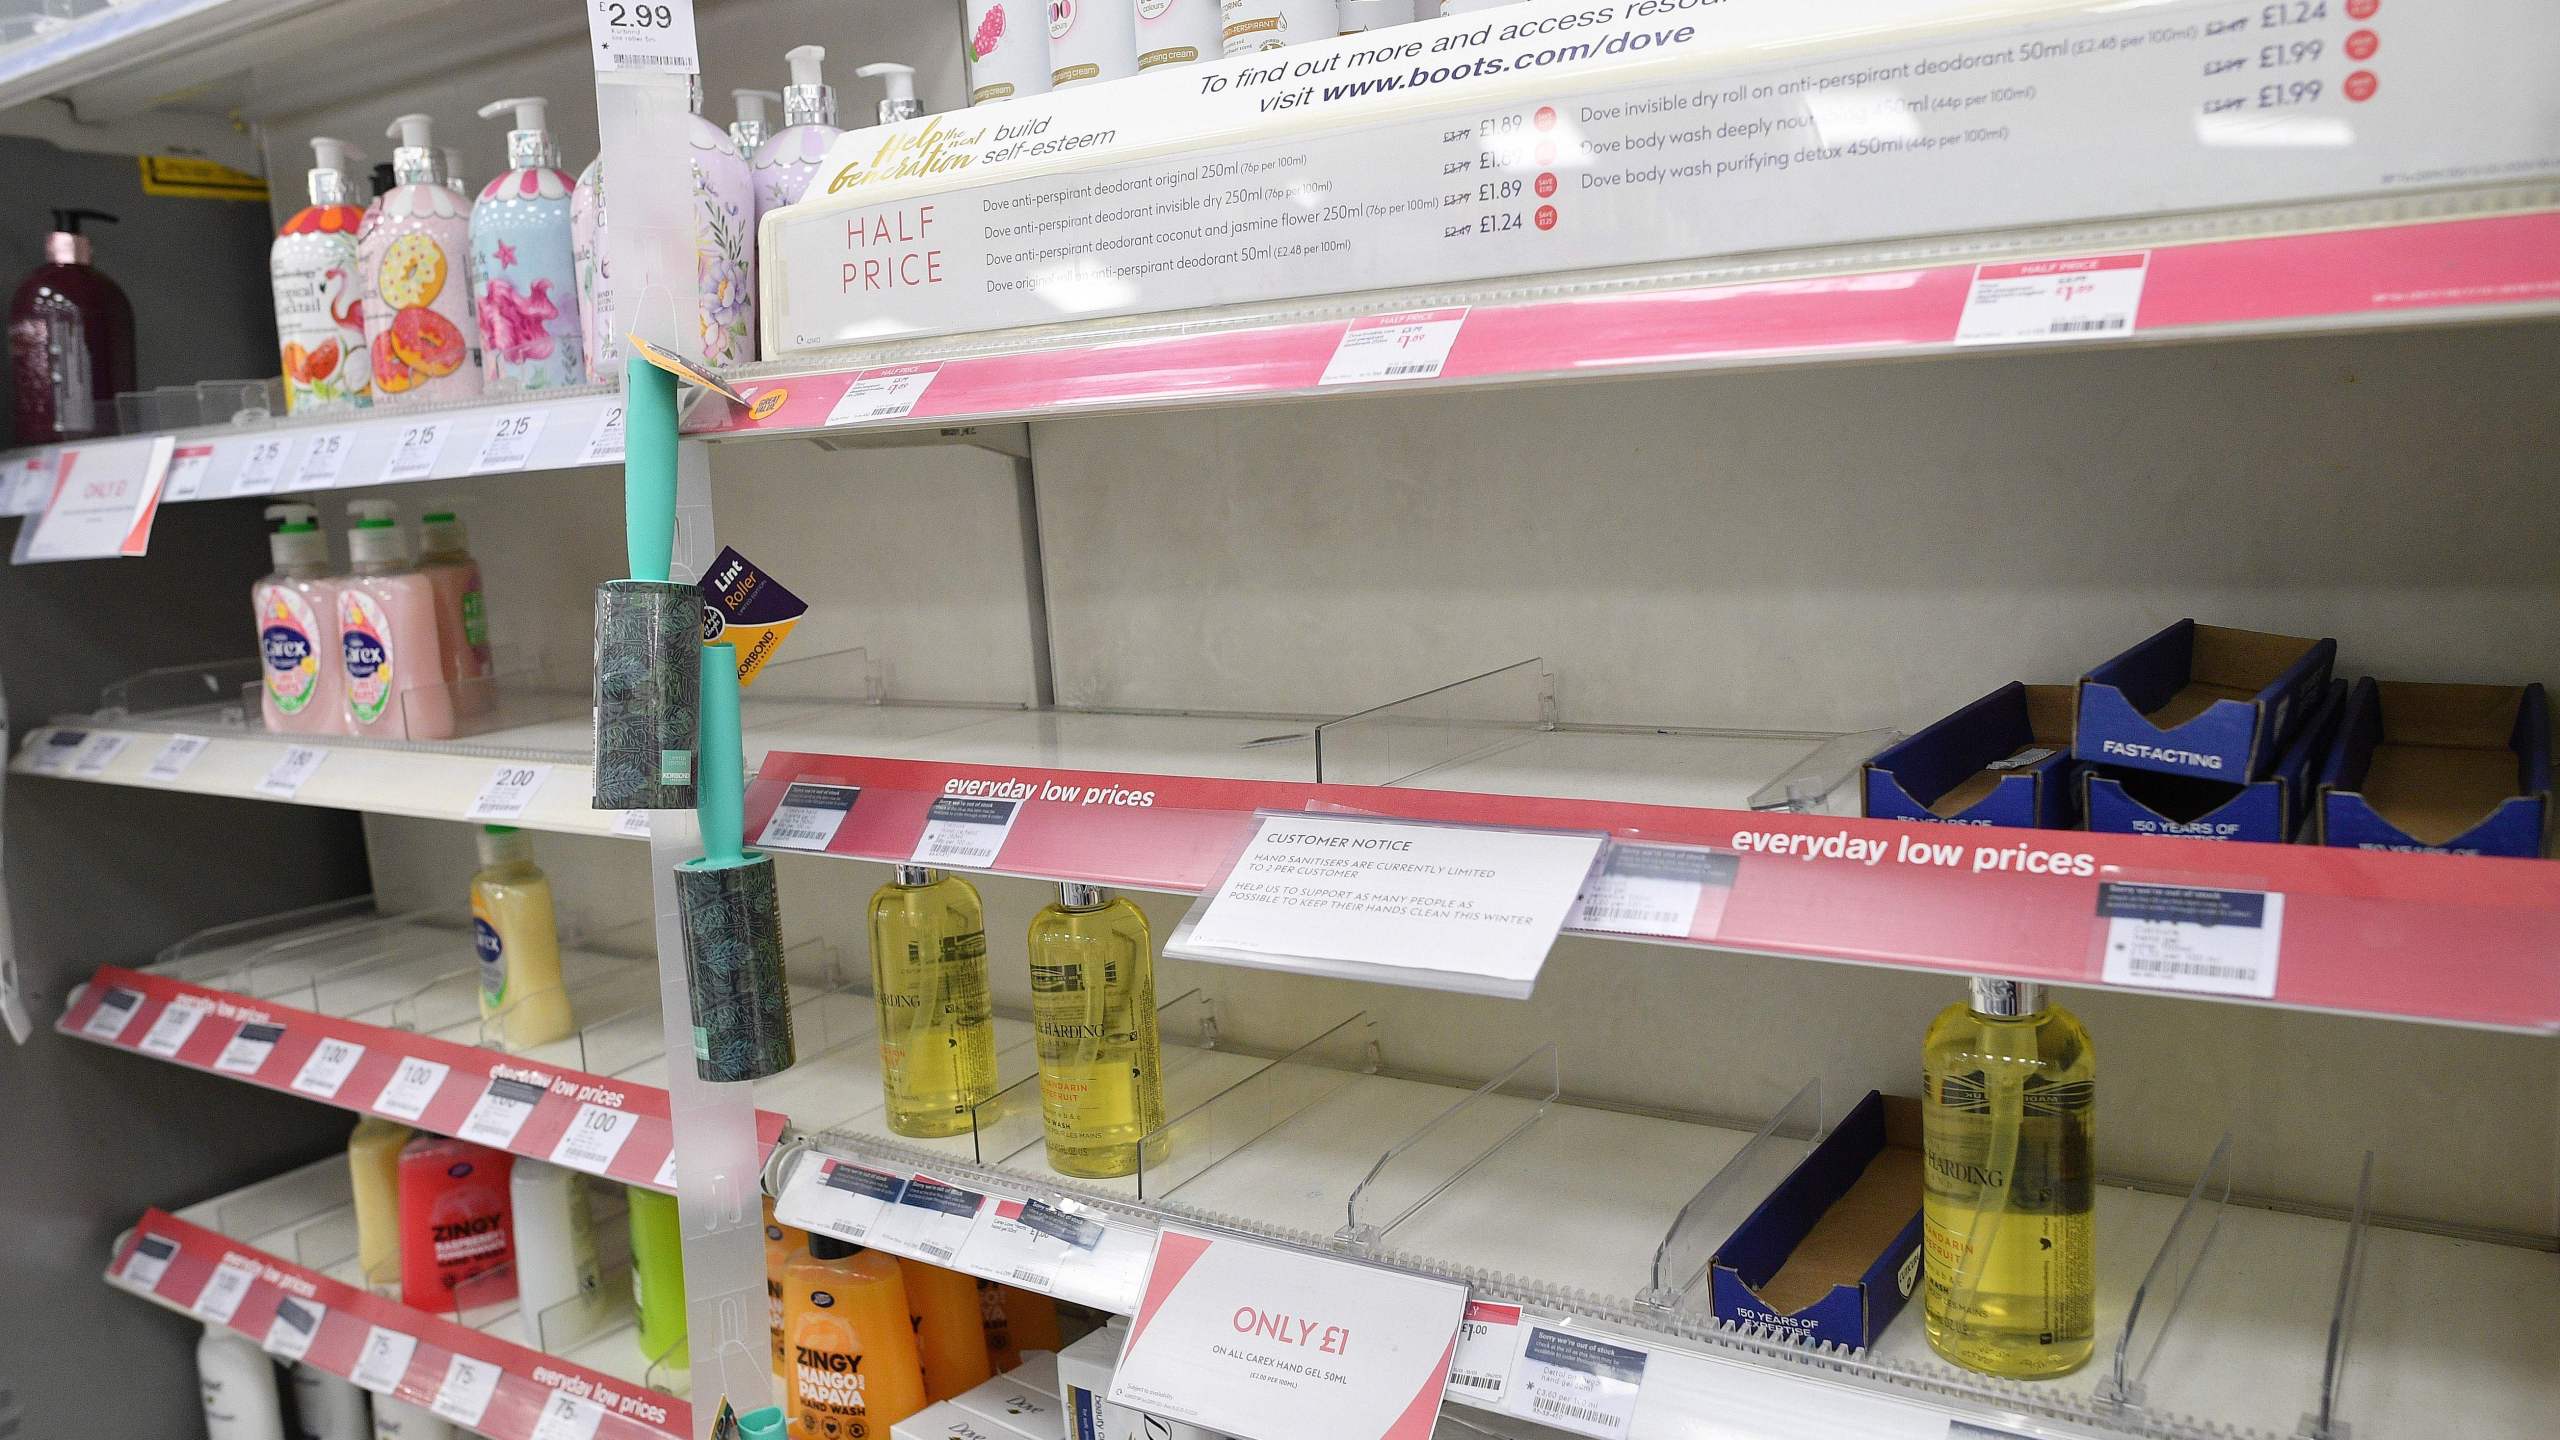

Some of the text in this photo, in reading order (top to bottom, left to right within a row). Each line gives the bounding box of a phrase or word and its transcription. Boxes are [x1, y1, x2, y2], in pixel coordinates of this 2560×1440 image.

[2259, 1, 2328, 30] £1.24
[1168, 48, 1194, 60] cream
[1201, 6, 1614, 95] To find out more and access
[2258, 38, 2325, 70] £1.99
[1071, 66, 1096, 78] cream
[1260, 26, 1695, 113] visit www.boots.com/dove
[1581, 38, 2070, 123] Dove invisible dry roll on anti-perspirant deodorant 50ml
[2257, 78, 2323, 110] £1.99
[993, 116, 1052, 143] build
[1479, 114, 1522, 138] £1.89
[1625, 117, 1773, 152] body wash deeply
[981, 128, 1116, 165] self-esteem
[1581, 135, 1904, 190] Dove body wash purifying detox 450ml
[827, 150, 977, 194] Generation
[983, 154, 1307, 213] Dove anti-perspirant deodorant original 250ml 100ml)
[1479, 179, 1522, 201] £1.89
[847, 205, 935, 250] HALF
[984, 186, 1263, 240] Dove anti-perspirant deodorant invisible dry 250ml
[1479, 212, 1522, 234] £1.24
[985, 196, 1439, 267] Dove anti-perspirant deodorant coconut and jasmine flower 250ml 100ml)
[842, 250, 943, 294] PRICE
[987, 239, 1351, 293] Dove deodorant 50ml 100ml)
[713, 559, 743, 593] Lint
[724, 570, 757, 611] Roller
[736, 629, 774, 681] KORBOND
[943, 776, 1156, 808] everyday low prices
[1267, 833, 1412, 852] CUSTOMER NOTICE
[2132, 820, 2240, 836] 150 YEARS OF
[1254, 853, 1496, 878] HAND SANITISERS ARE CURRENTLY LIMITED
[1731, 828, 1889, 866] everyday
[1896, 835, 1964, 867] low
[1972, 842, 2096, 878] prices
[1249, 863, 1264, 872] TO
[1274, 865, 1295, 874] PER
[1297, 866, 1359, 878] CUSTOMER
[1228, 891, 1534, 925] POSSIBLE TO KEEP THEIR HANDS CLEAN WINTER
[1234, 881, 1457, 908] HELP SUPPORT MANY PEOPLE
[1044, 1022, 1106, 1039] HARDING
[550, 1076, 580, 1097] low
[576, 1084, 626, 1108] prices
[1052, 1120, 1071, 1130] WASH
[1927, 1150, 2004, 1188] HARDING
[432, 1212, 501, 1242] ZINGY
[1233, 1306, 1350, 1356] ONLY £1
[1461, 1323, 1488, 1342] £1.00
[1736, 1306, 1819, 1329] 150 YEARS OF
[796, 1345, 863, 1374] ZINGY
[1538, 1332, 1556, 1344] Sorry
[1557, 1336, 1576, 1347] we're
[1576, 1341, 1588, 1350] out
[1597, 1346, 1616, 1357] stock
[797, 1363, 858, 1391] MANGO
[1212, 1344, 1348, 1385] ON ALL CAREX HAND GEL 50ML
[592, 1382, 668, 1425] low prices
[798, 1379, 865, 1407] PAPAYA
[1004, 1393, 1045, 1415] Dove
[829, 1404, 866, 1416] WASH
[947, 1420, 988, 1440] Dove
